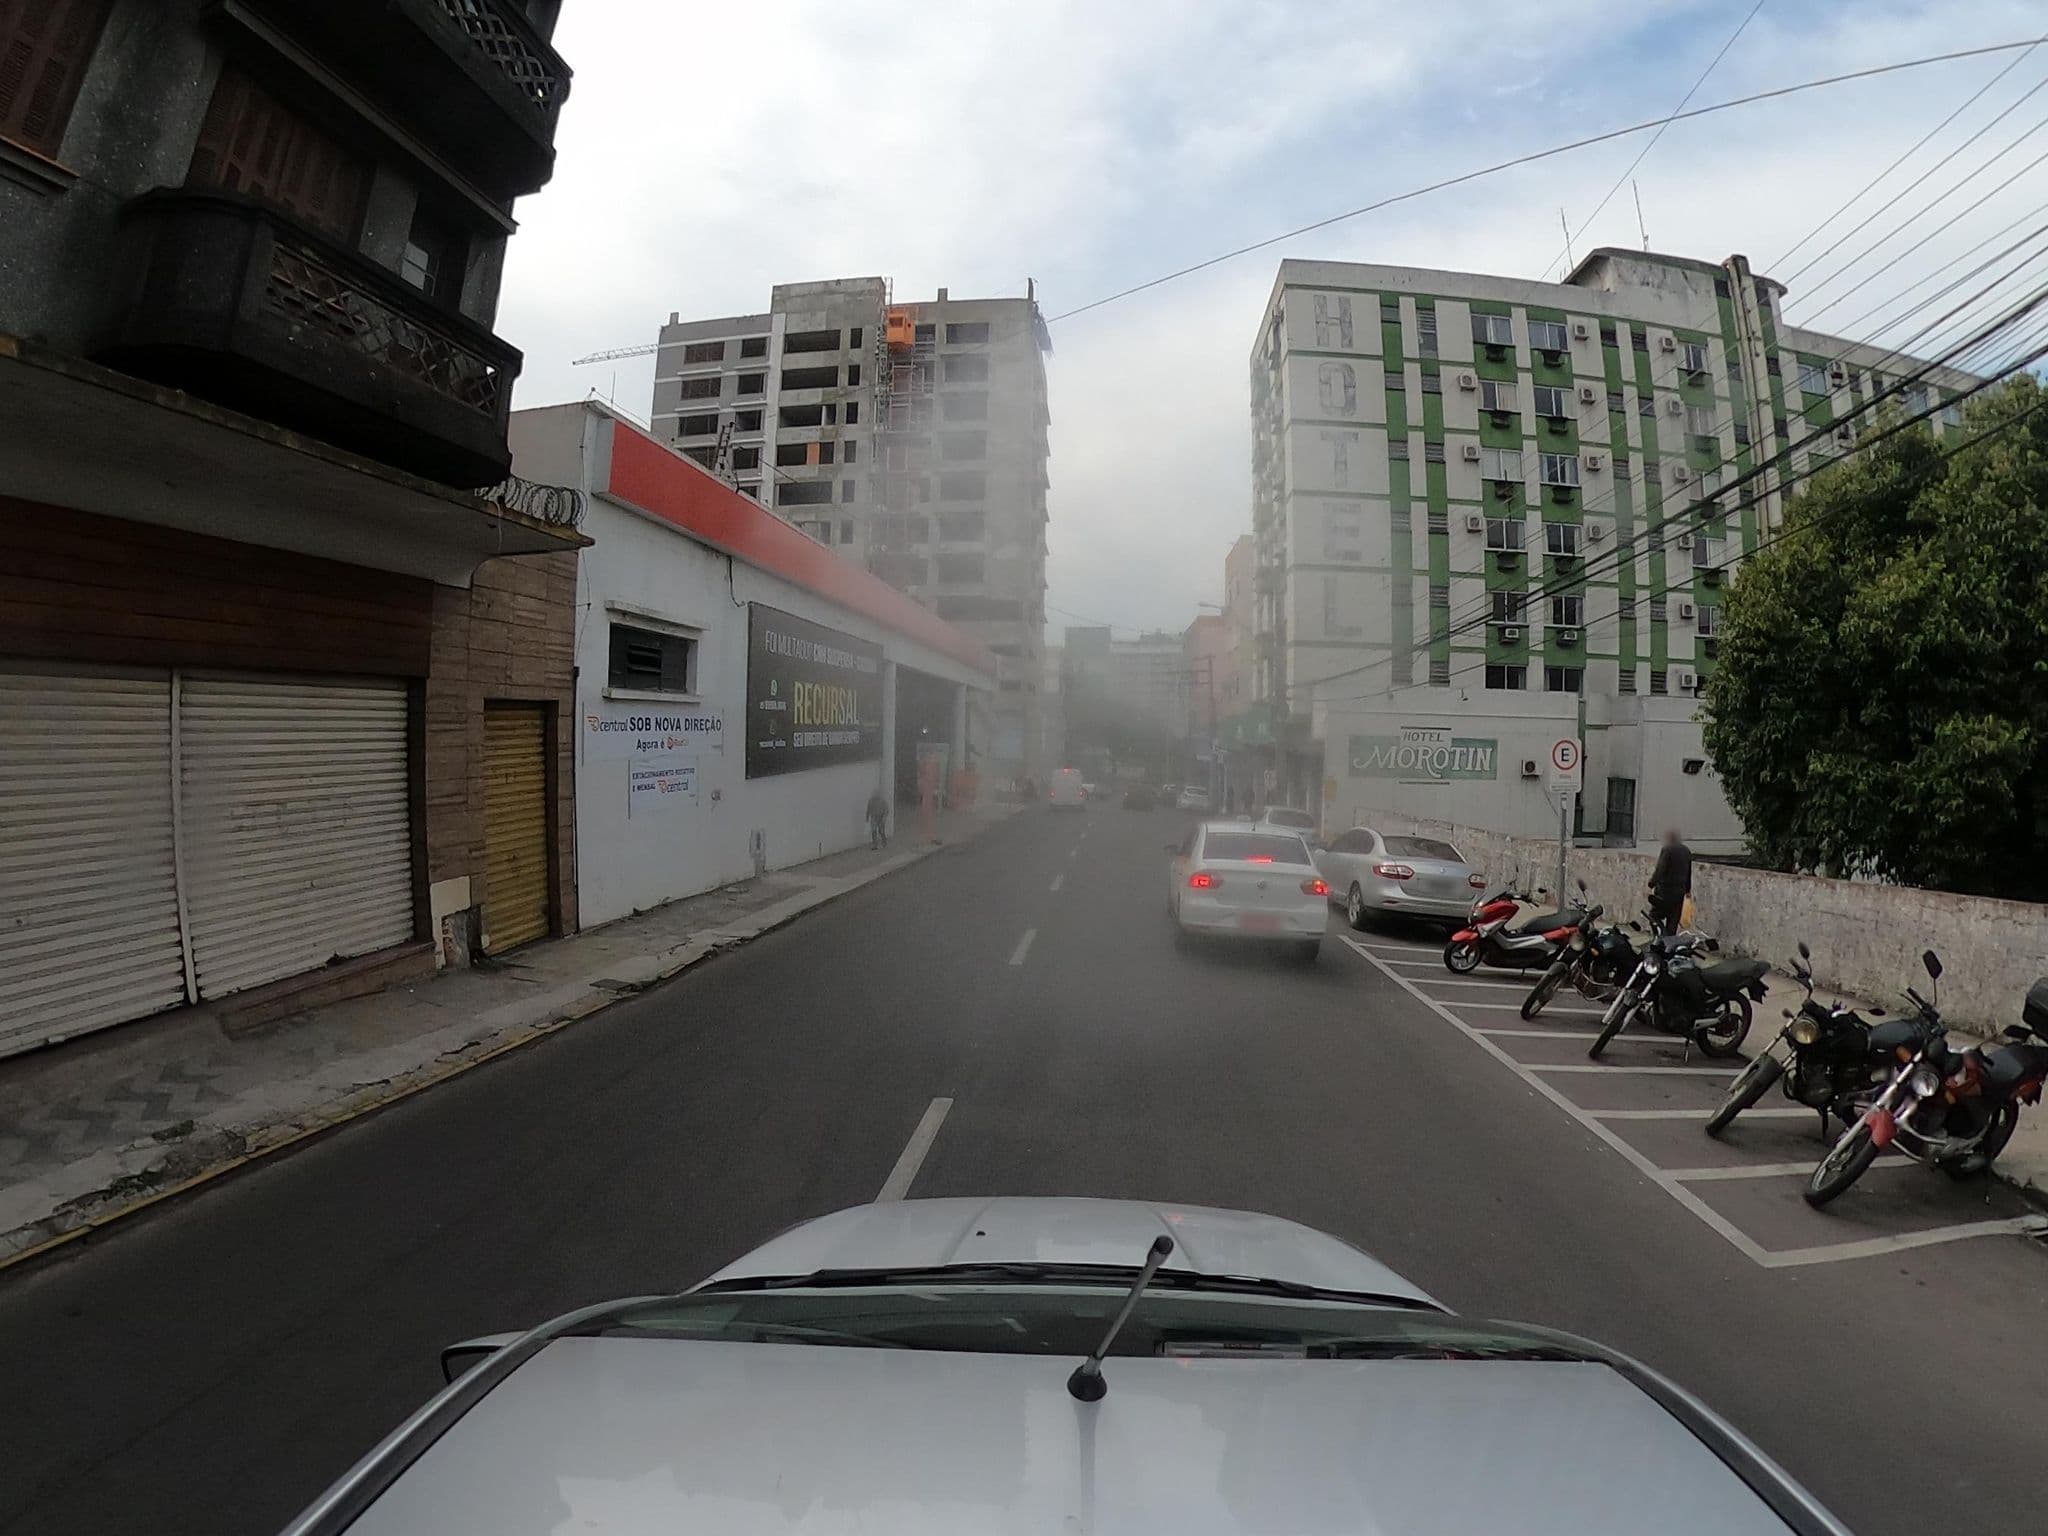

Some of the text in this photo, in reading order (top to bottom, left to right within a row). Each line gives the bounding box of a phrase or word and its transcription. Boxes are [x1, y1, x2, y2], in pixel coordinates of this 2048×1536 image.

[793, 681, 860, 725] RECURSAL
[629, 716, 651, 731] SOB
[655, 717, 682, 732] NOVA
[684, 715, 722, 734] DIREÇÃO
[636, 739, 658, 752] Agora
[1403, 731, 1445, 743] HOTEL
[1352, 744, 1493, 778] MOROTIN
[1561, 747, 1570, 762] E
